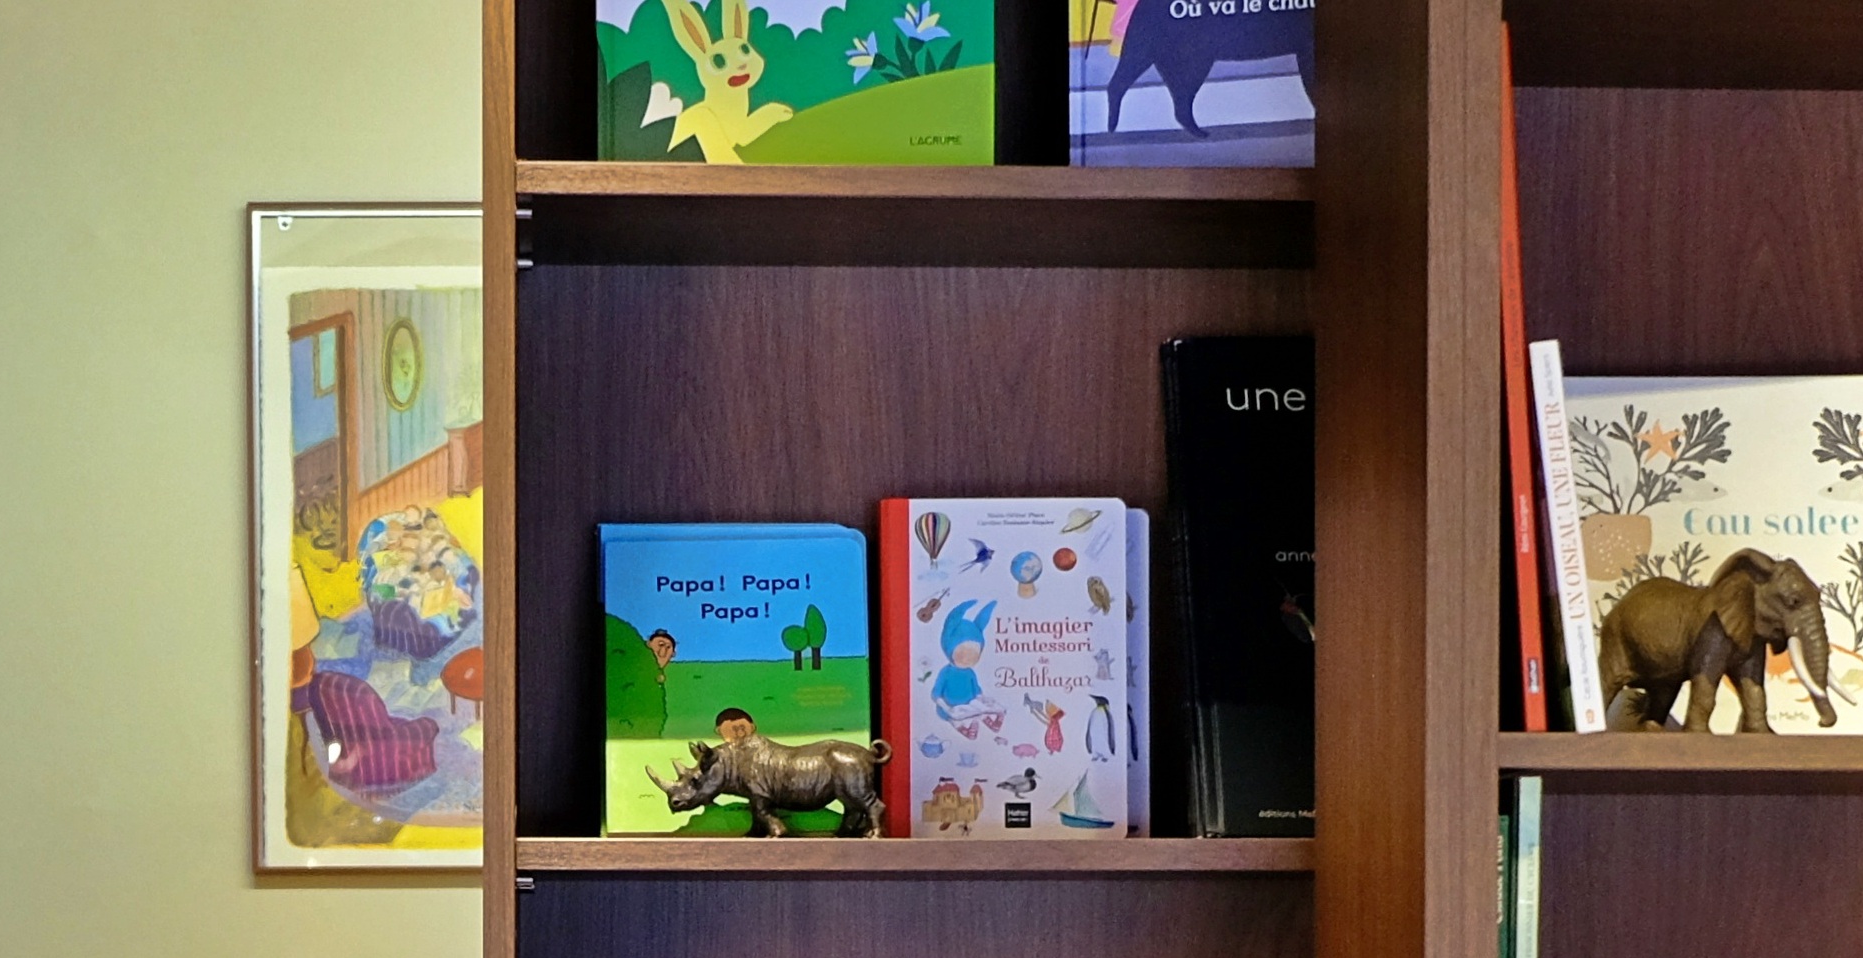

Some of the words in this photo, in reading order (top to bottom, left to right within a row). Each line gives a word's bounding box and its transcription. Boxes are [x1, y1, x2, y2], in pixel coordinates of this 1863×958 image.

[1169, 0, 1202, 19] Où
[1208, 1, 1237, 15] va
[1243, 0, 1262, 13] le
[1225, 387, 1306, 411] une
[1544, 401, 1566, 465] FLEUR
[1551, 466, 1572, 509] UNE
[1556, 510, 1581, 587] OISEAU,
[1568, 591, 1586, 620] UN
[995, 616, 1094, 640] L'imagier
[994, 637, 1094, 653] Montessori
[994, 666, 1093, 692] Balthazar
